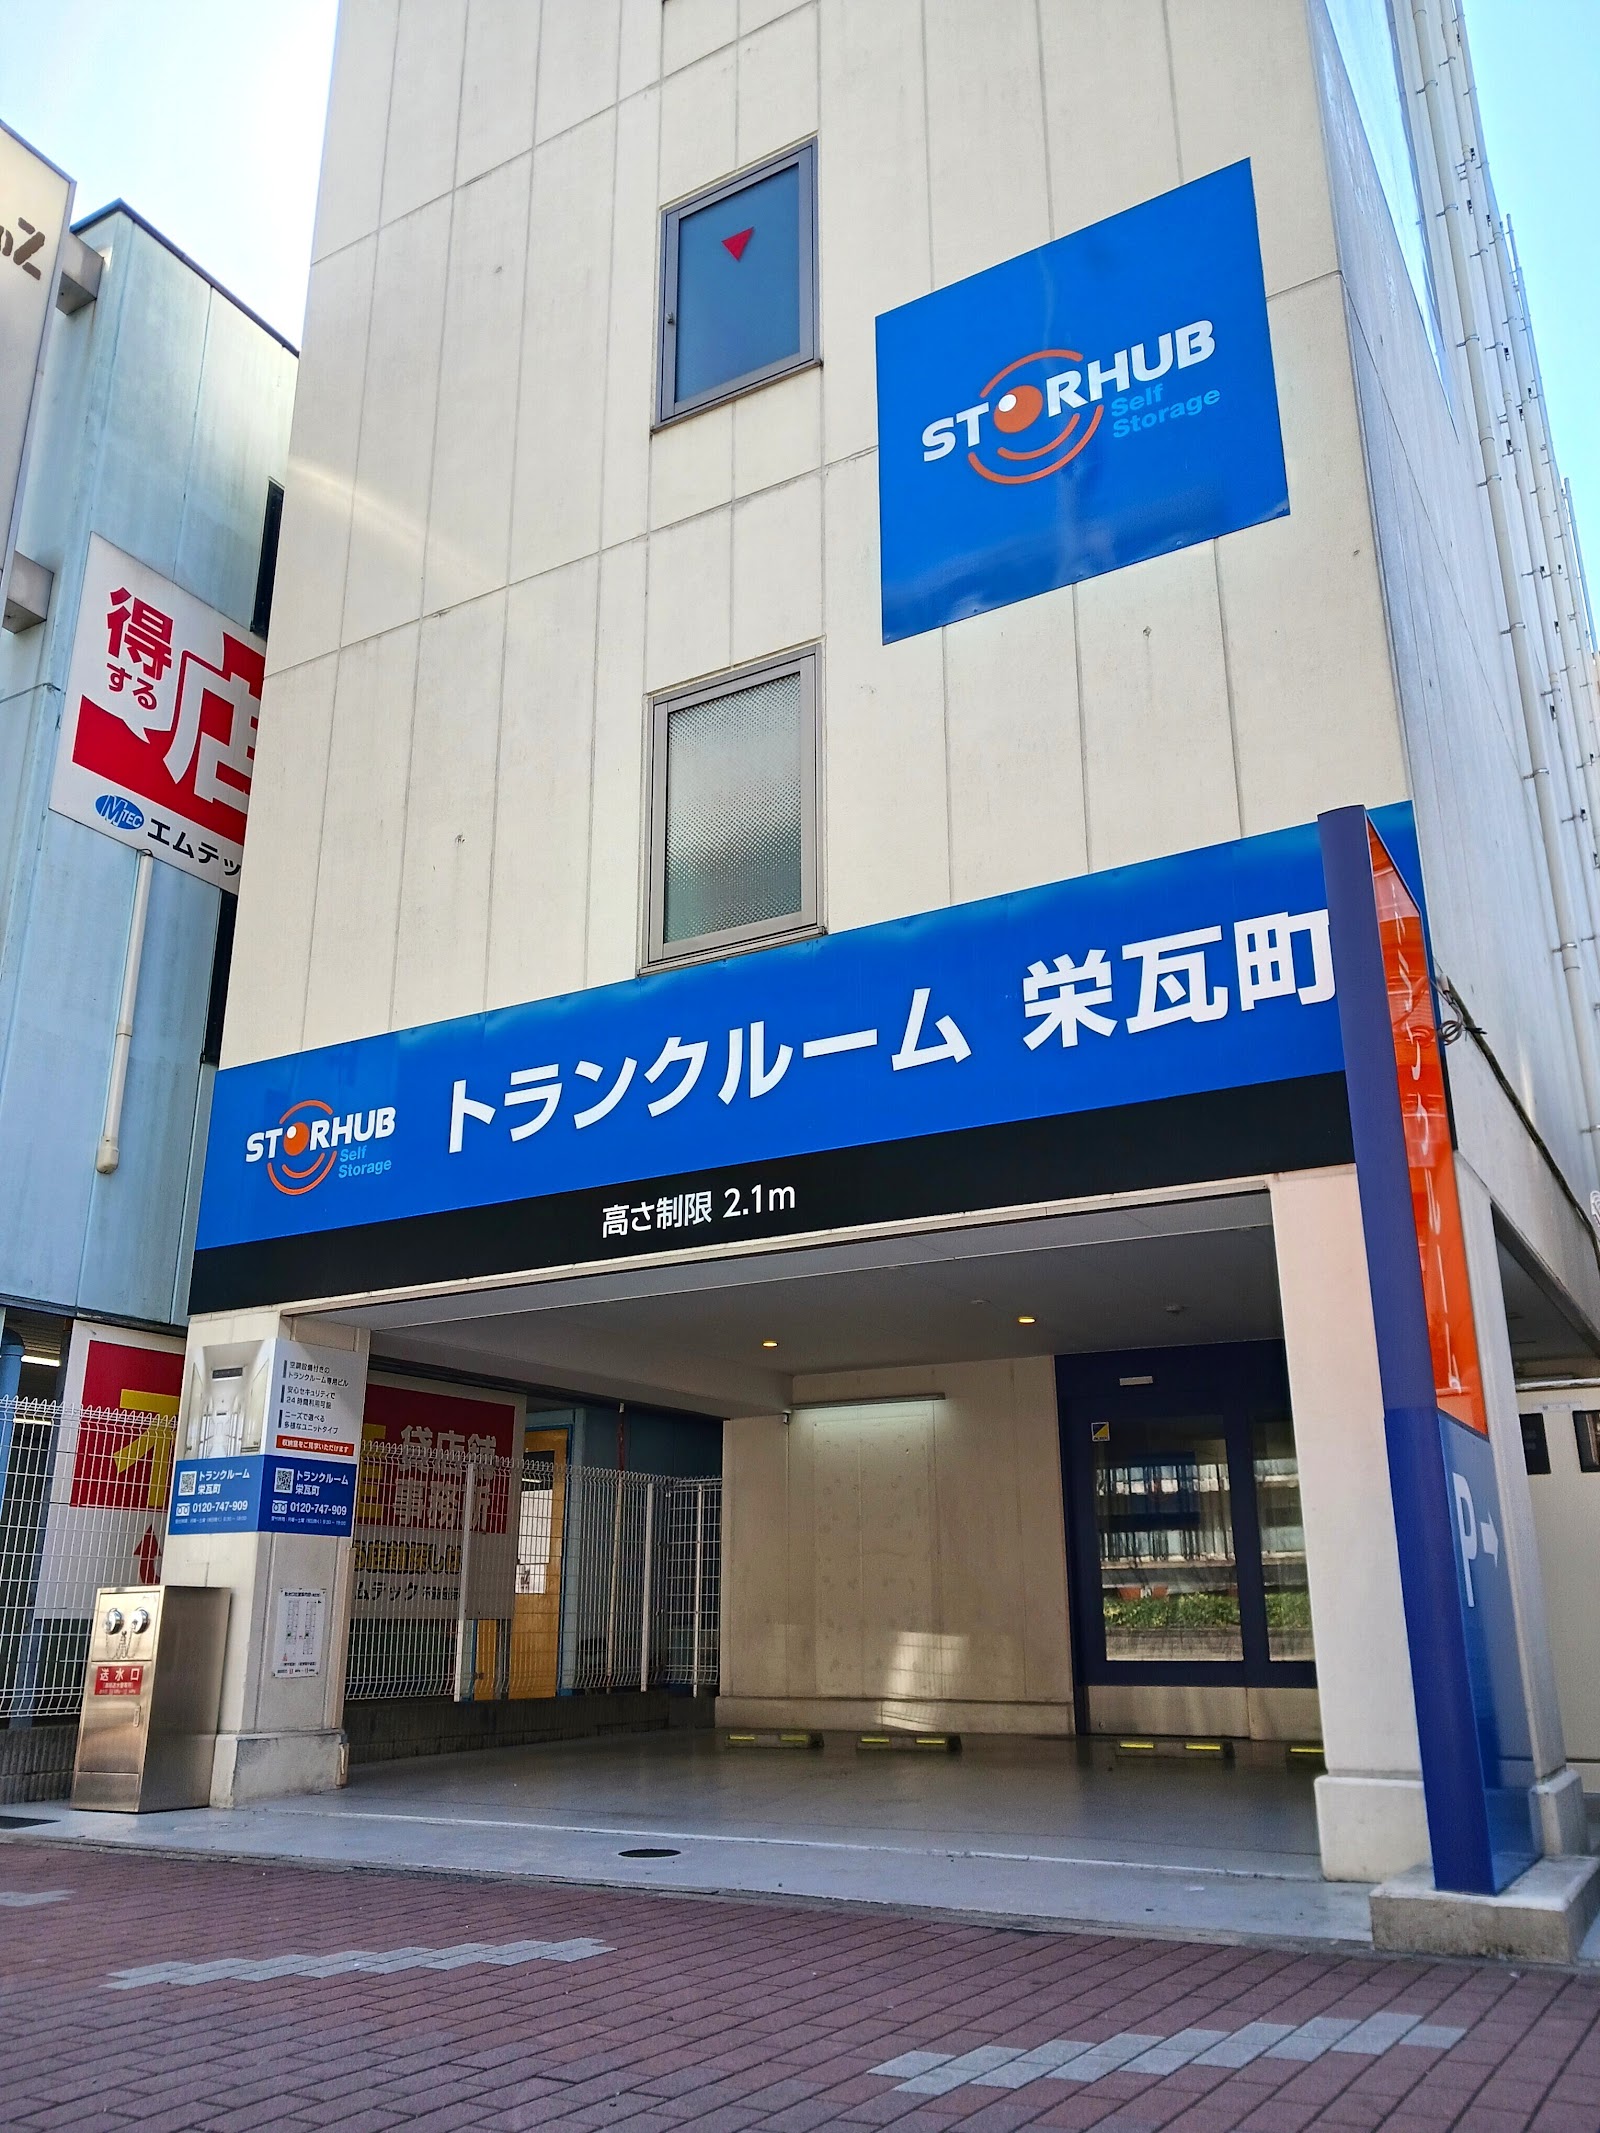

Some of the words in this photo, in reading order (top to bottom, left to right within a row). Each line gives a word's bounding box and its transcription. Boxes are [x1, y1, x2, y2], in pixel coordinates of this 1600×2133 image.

[922, 318, 1216, 462] STORHUB
[1111, 382, 1164, 418] Self
[1112, 386, 1221, 439] Storage
[106, 587, 174, 681] 得
[106, 663, 158, 711] する
[448, 988, 971, 1154] トランクルーム
[1023, 909, 1337, 1050] 栄瓦町
[245, 1105, 396, 1163] STORHUB
[337, 1157, 392, 1180] Storage
[339, 1145, 367, 1164] Self
[601, 1190, 713, 1238] 高さ制限
[723, 1183, 797, 1219] 2.1m
[197, 1484, 221, 1495] 栄瓦町
[198, 1468, 250, 1482] トランクルーム
[295, 1483, 320, 1496] 栄瓦町
[296, 1470, 349, 1485] トランクルーム
[192, 1500, 248, 1514] 0120-747-909
[290, 1502, 347, 1516] 0120-747-909
[1452, 1471, 1478, 1608] P
[100, 1668, 140, 1682] 送水口
